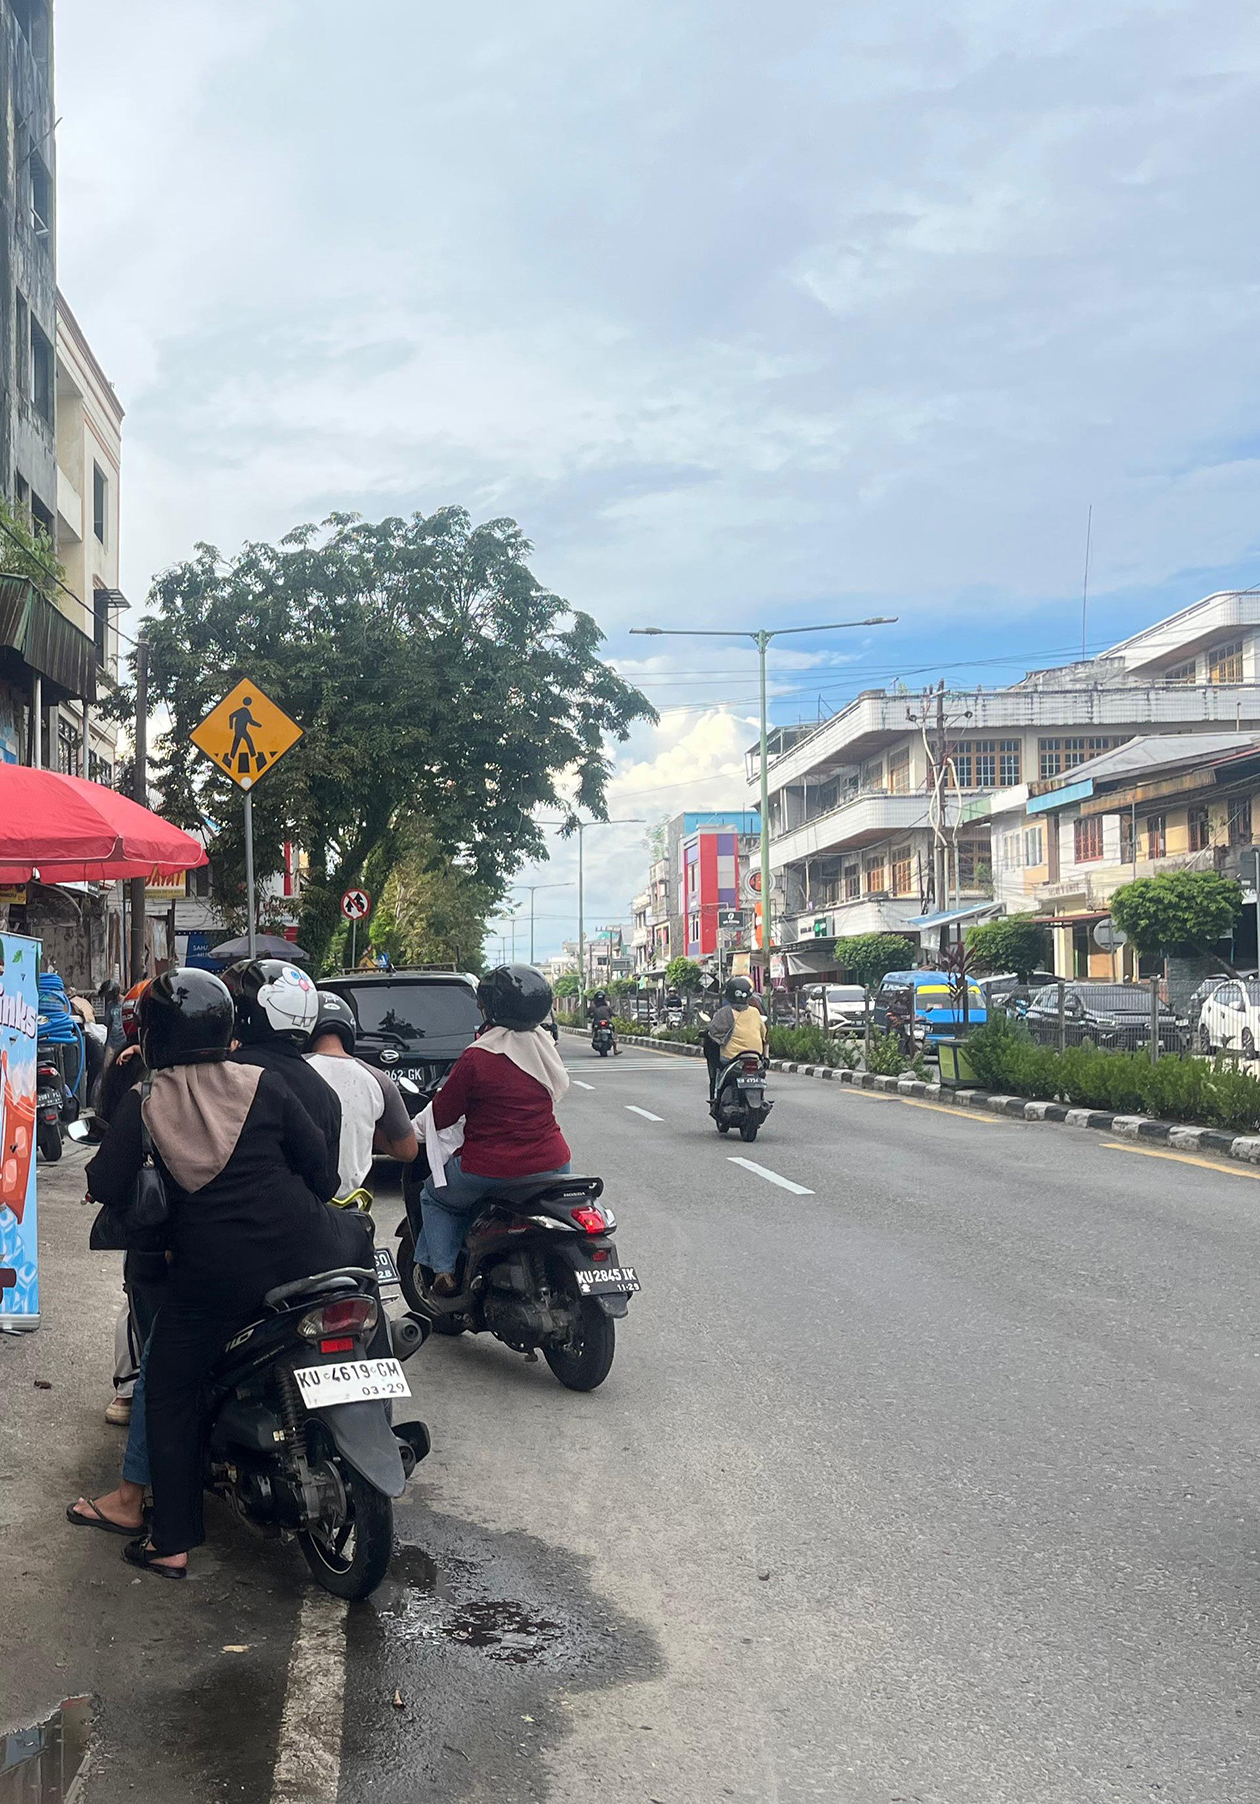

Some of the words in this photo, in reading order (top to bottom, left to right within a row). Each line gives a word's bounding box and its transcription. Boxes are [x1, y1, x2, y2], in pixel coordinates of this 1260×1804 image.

[407, 1068, 422, 1081] GK
[575, 1270, 594, 1284] KU
[593, 1268, 622, 1283] 2845
[621, 1267, 637, 1281] IK
[296, 1370, 321, 1389] KU
[332, 1364, 371, 1383] 4619
